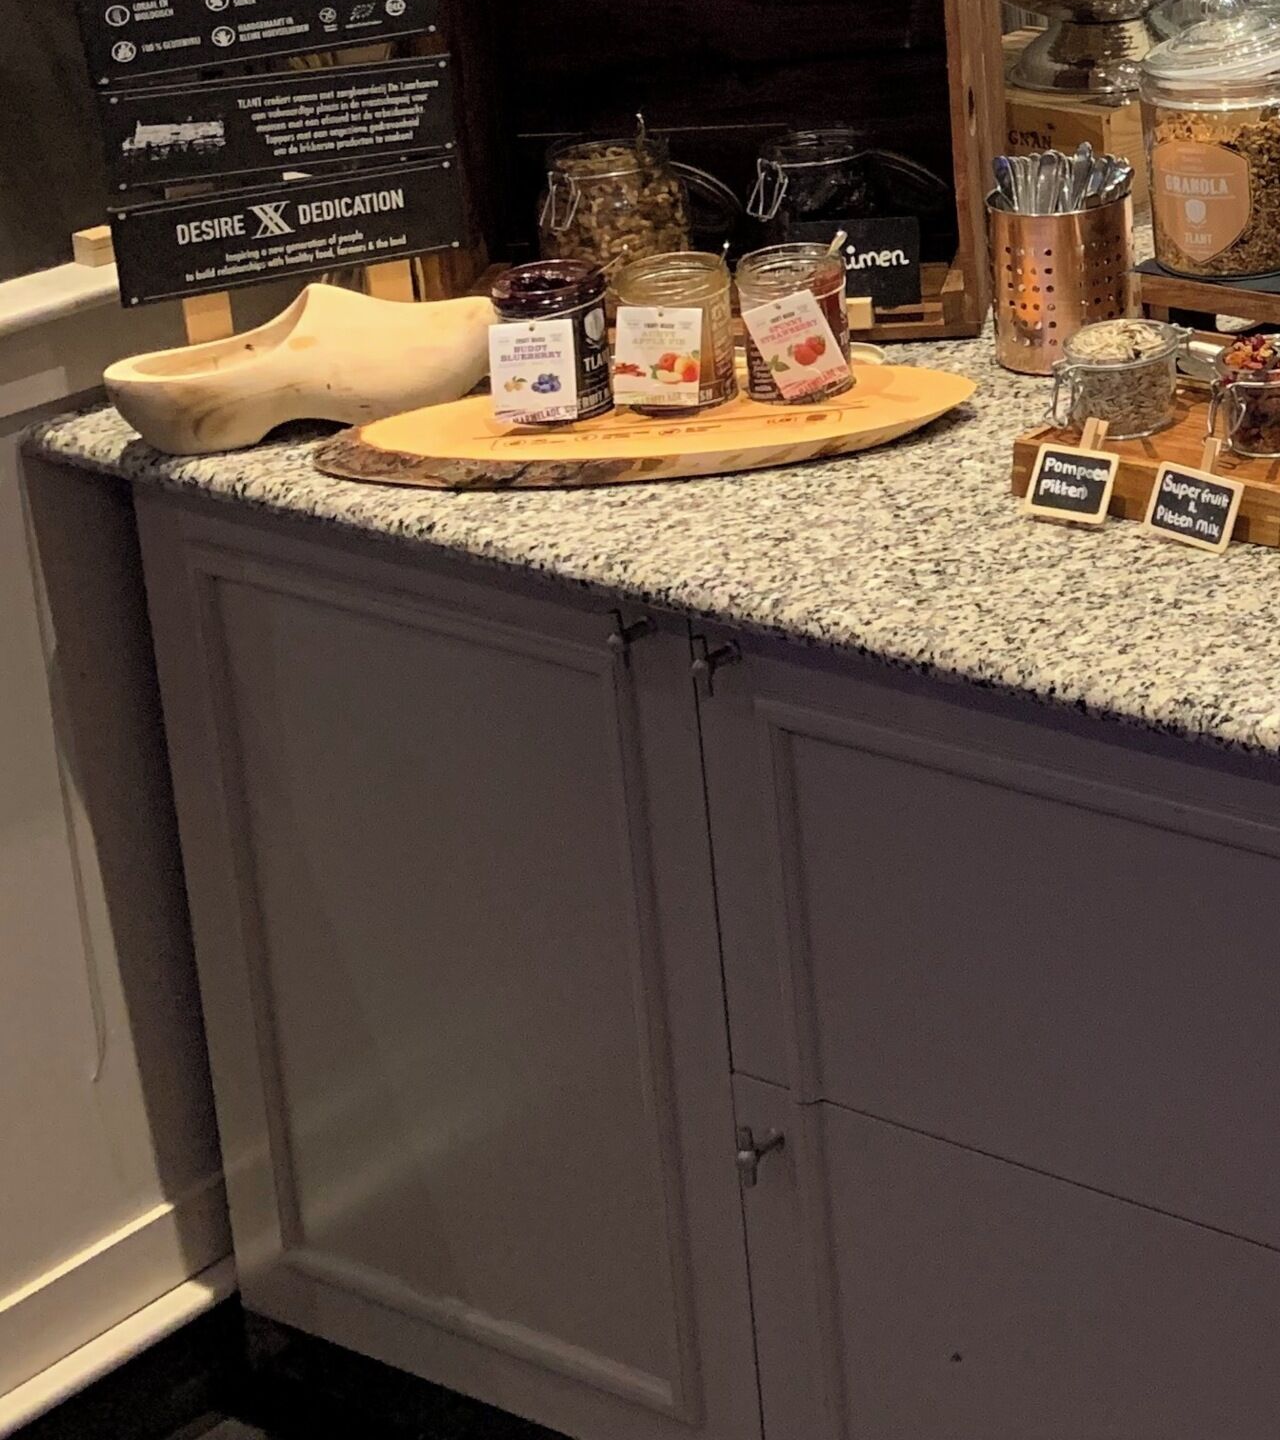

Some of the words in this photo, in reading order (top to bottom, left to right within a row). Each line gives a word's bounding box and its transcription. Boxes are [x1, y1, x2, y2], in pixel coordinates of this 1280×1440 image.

[1165, 175, 1228, 194] GRANOLA
[176, 215, 245, 245] DESIRE
[298, 189, 404, 225] DEDICATION
[328, 234, 336, 245] of
[339, 231, 363, 244] people
[376, 239, 388, 248] the
[1184, 232, 1212, 244] TLANT
[500, 351, 561, 362] BLUEBERRY
[1045, 457, 1109, 481] Pompoen
